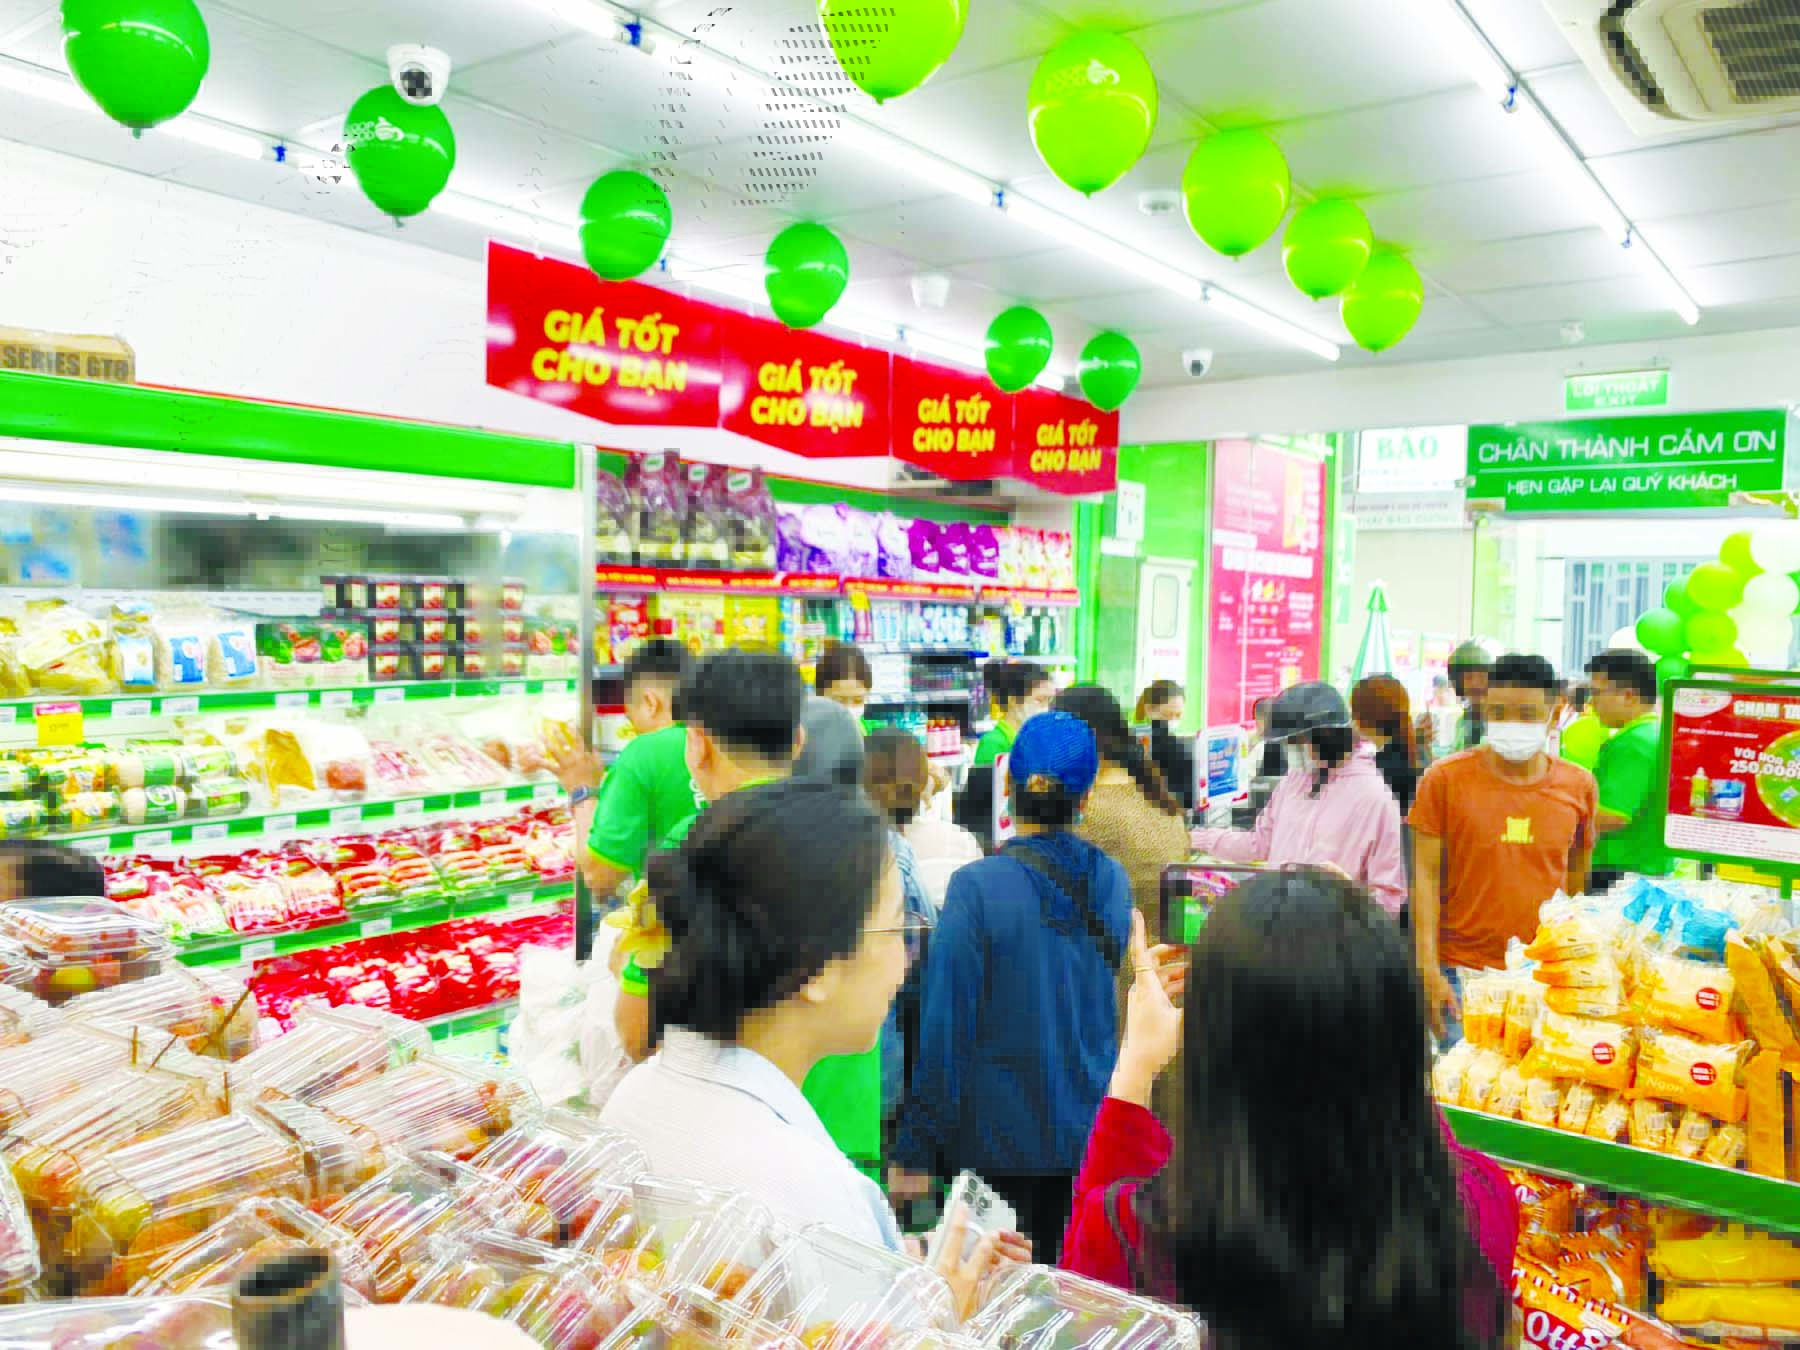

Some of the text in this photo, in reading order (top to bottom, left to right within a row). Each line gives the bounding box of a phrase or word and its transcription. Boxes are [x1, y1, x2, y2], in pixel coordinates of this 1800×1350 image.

[543, 306, 680, 355] GIÁ TỐT
[532, 347, 689, 397] CHO BẠN
[758, 359, 858, 395] GIÁ TỐT
[750, 396, 865, 433] CHO BẠN
[918, 393, 991, 425] GIÁ TỐT
[912, 427, 995, 457] CHO BẠN
[1036, 418, 1098, 447] GIÁ TỐT
[1478, 436, 1548, 464] CHÂN
[1556, 433, 1649, 461] THÀNH
[1658, 427, 1723, 457] CẢM
[1030, 448, 1102, 475] CHO BẠN
[1507, 471, 1737, 497] HẸN GẶP LẠI QUÝ KHÁCH
